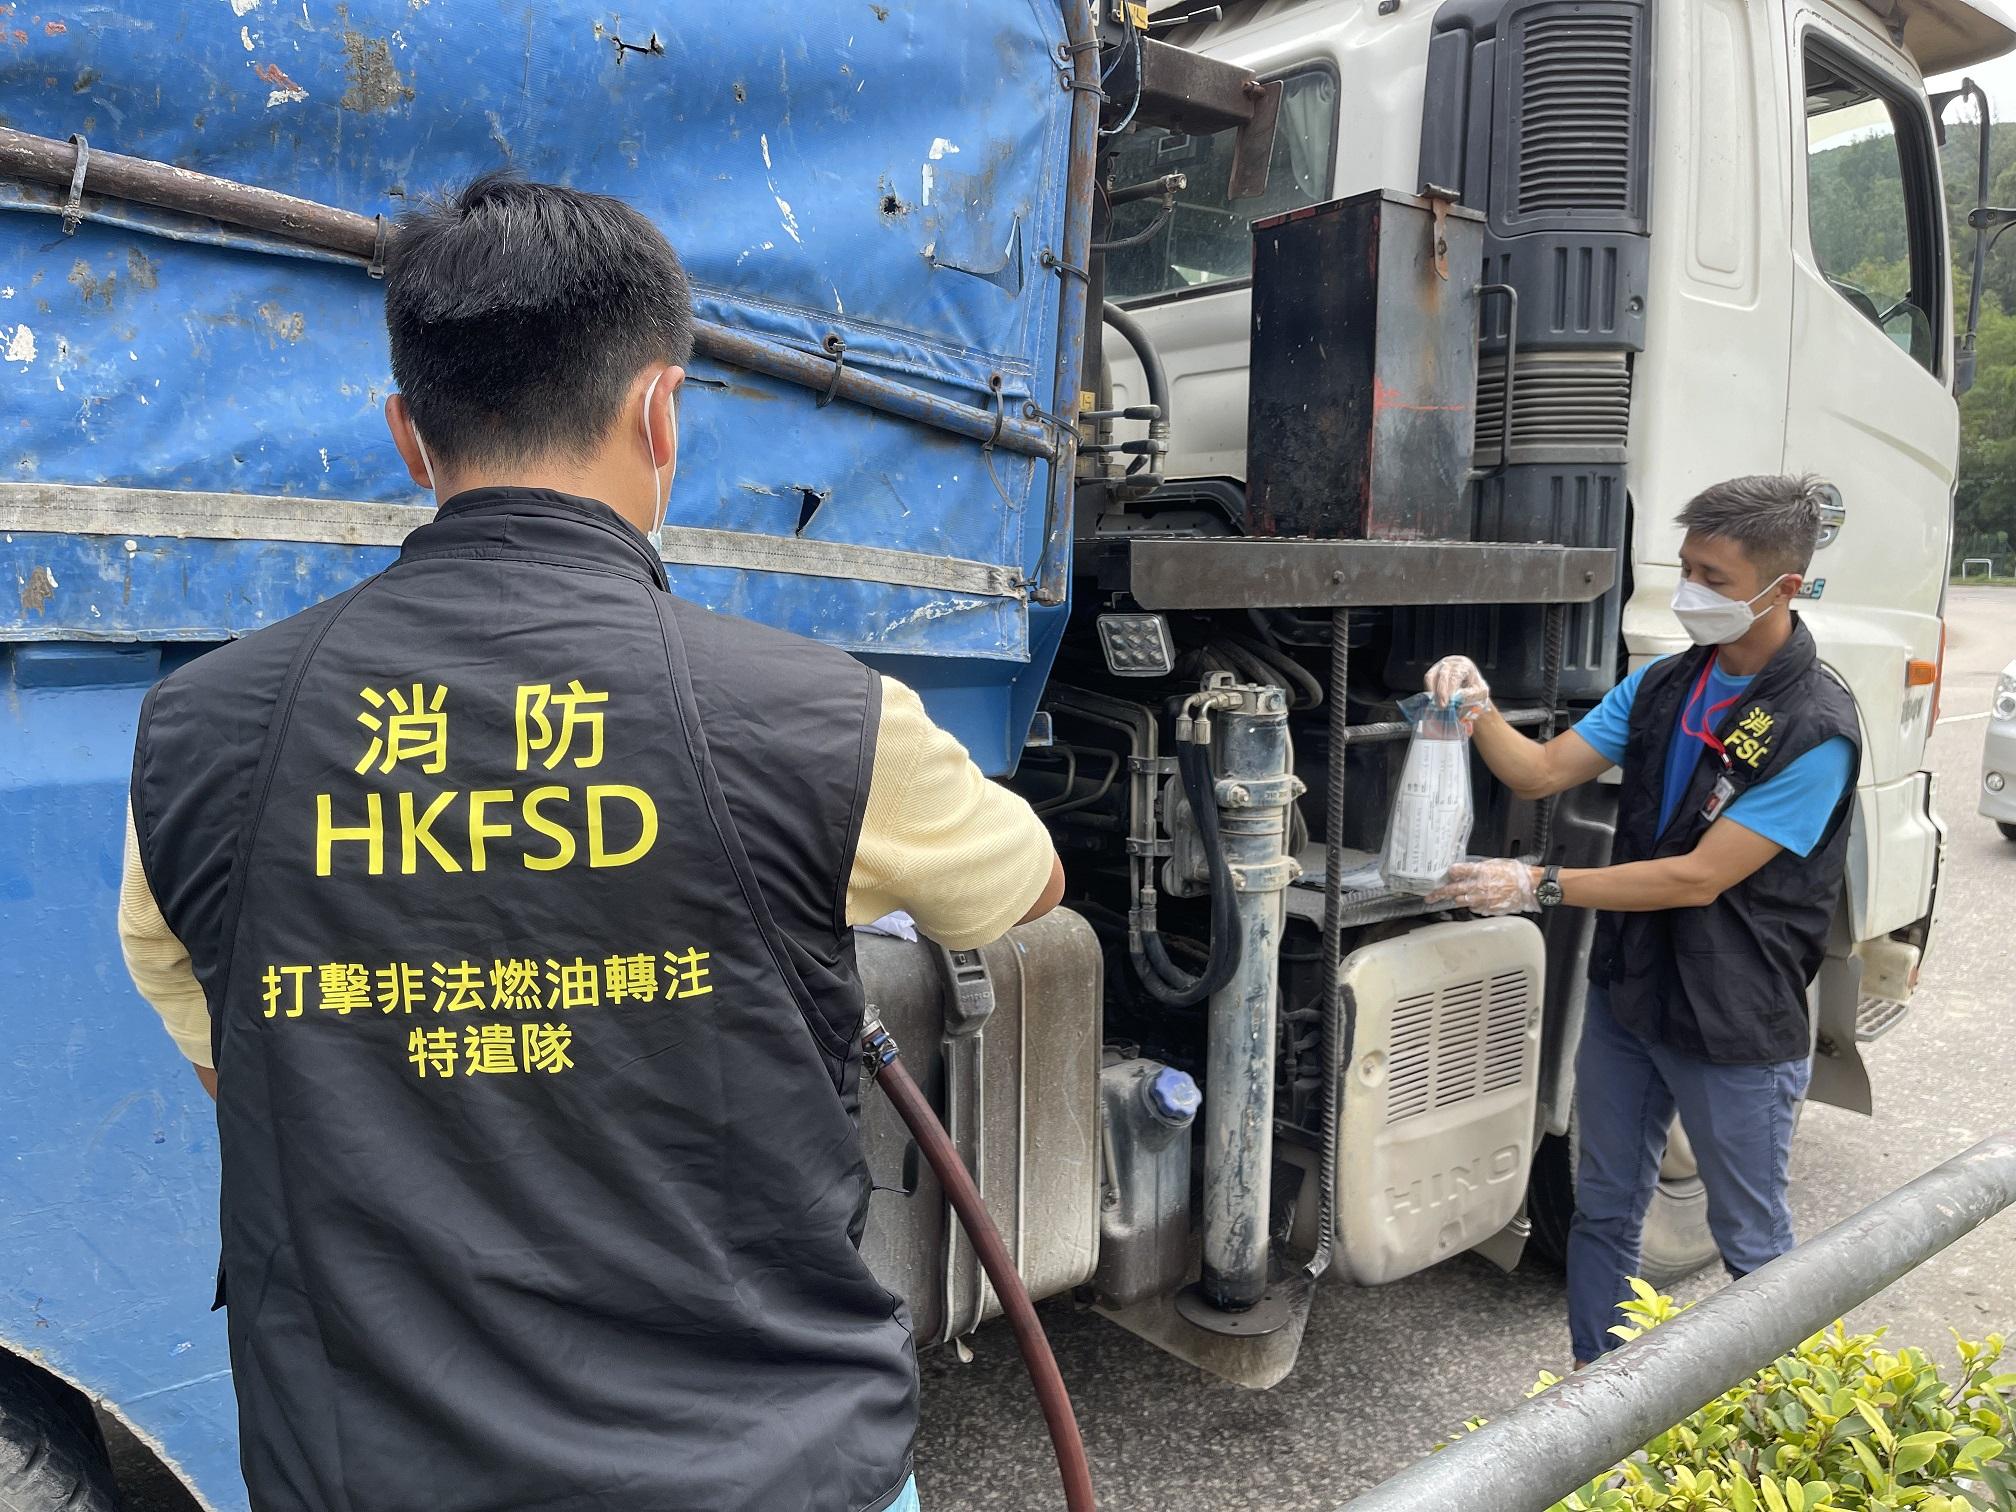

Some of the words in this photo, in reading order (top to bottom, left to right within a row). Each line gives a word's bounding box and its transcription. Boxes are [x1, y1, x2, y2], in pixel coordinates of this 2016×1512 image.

[354, 680, 609, 775] 消防
[315, 784, 659, 877] HKFSD
[261, 946, 714, 1019] 打擊非法燃油轉注
[407, 1022, 576, 1079] 特遣隊
[1383, 1144, 1521, 1223] HINO
